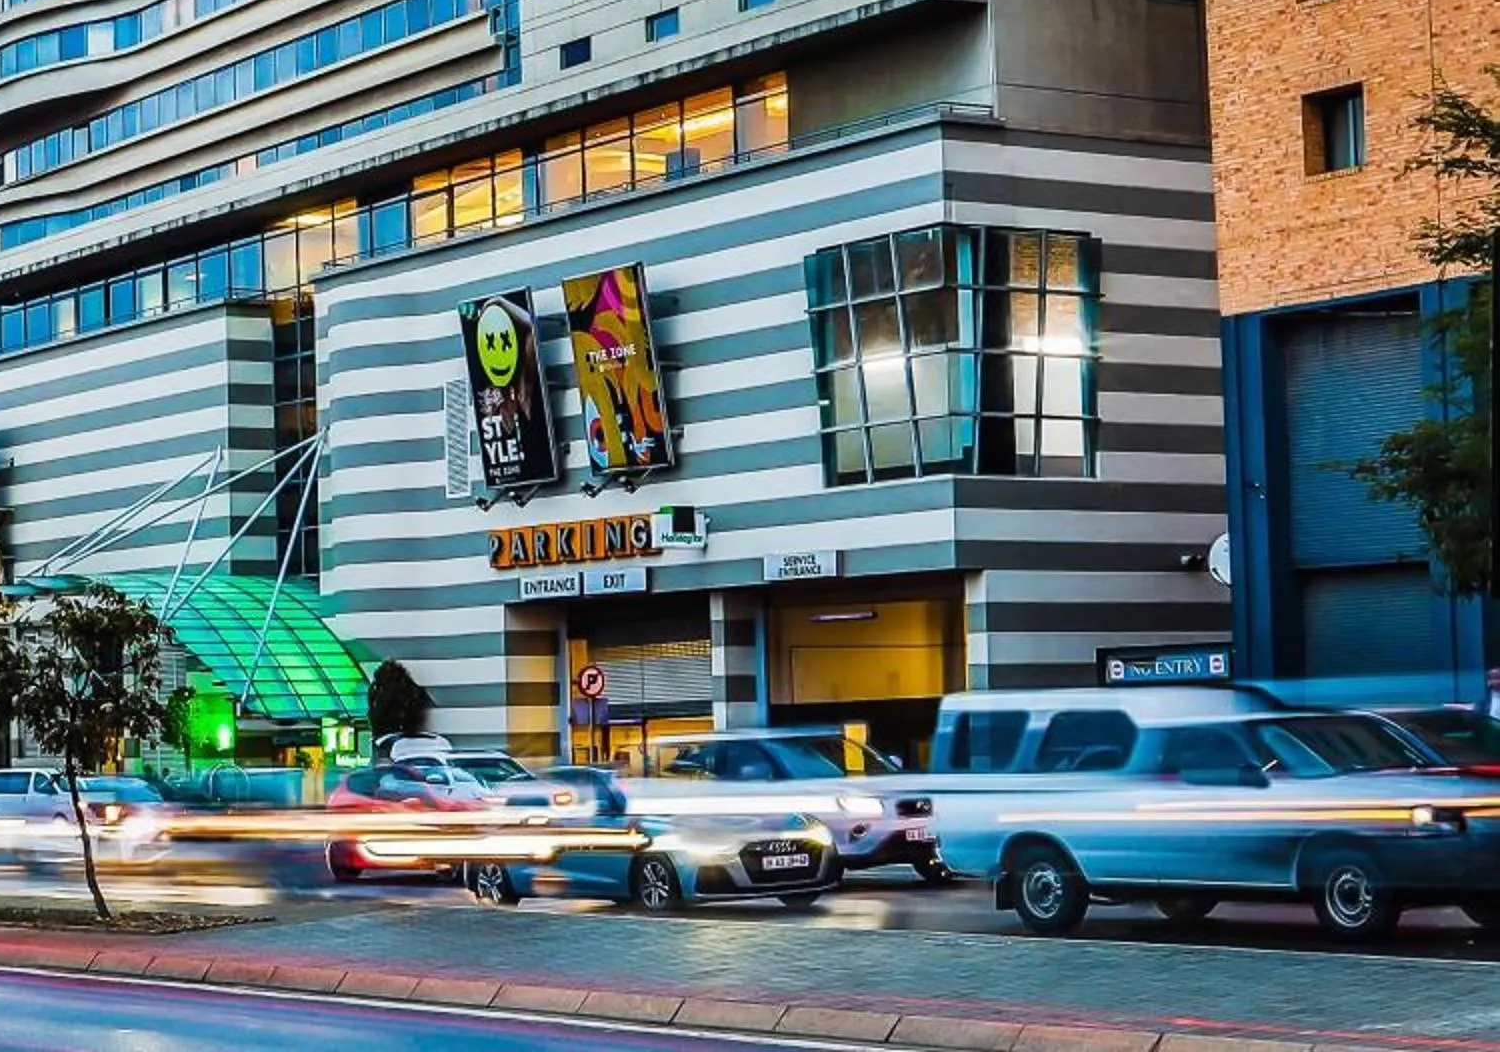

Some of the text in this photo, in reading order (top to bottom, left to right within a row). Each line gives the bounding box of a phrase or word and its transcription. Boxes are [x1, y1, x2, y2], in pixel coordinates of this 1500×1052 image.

[482, 415, 503, 440] ST
[488, 518, 648, 561] PARKING
[524, 577, 575, 595] ENTRANCE
[603, 574, 626, 588] EXIT
[1156, 658, 1203, 675] ENTRY
